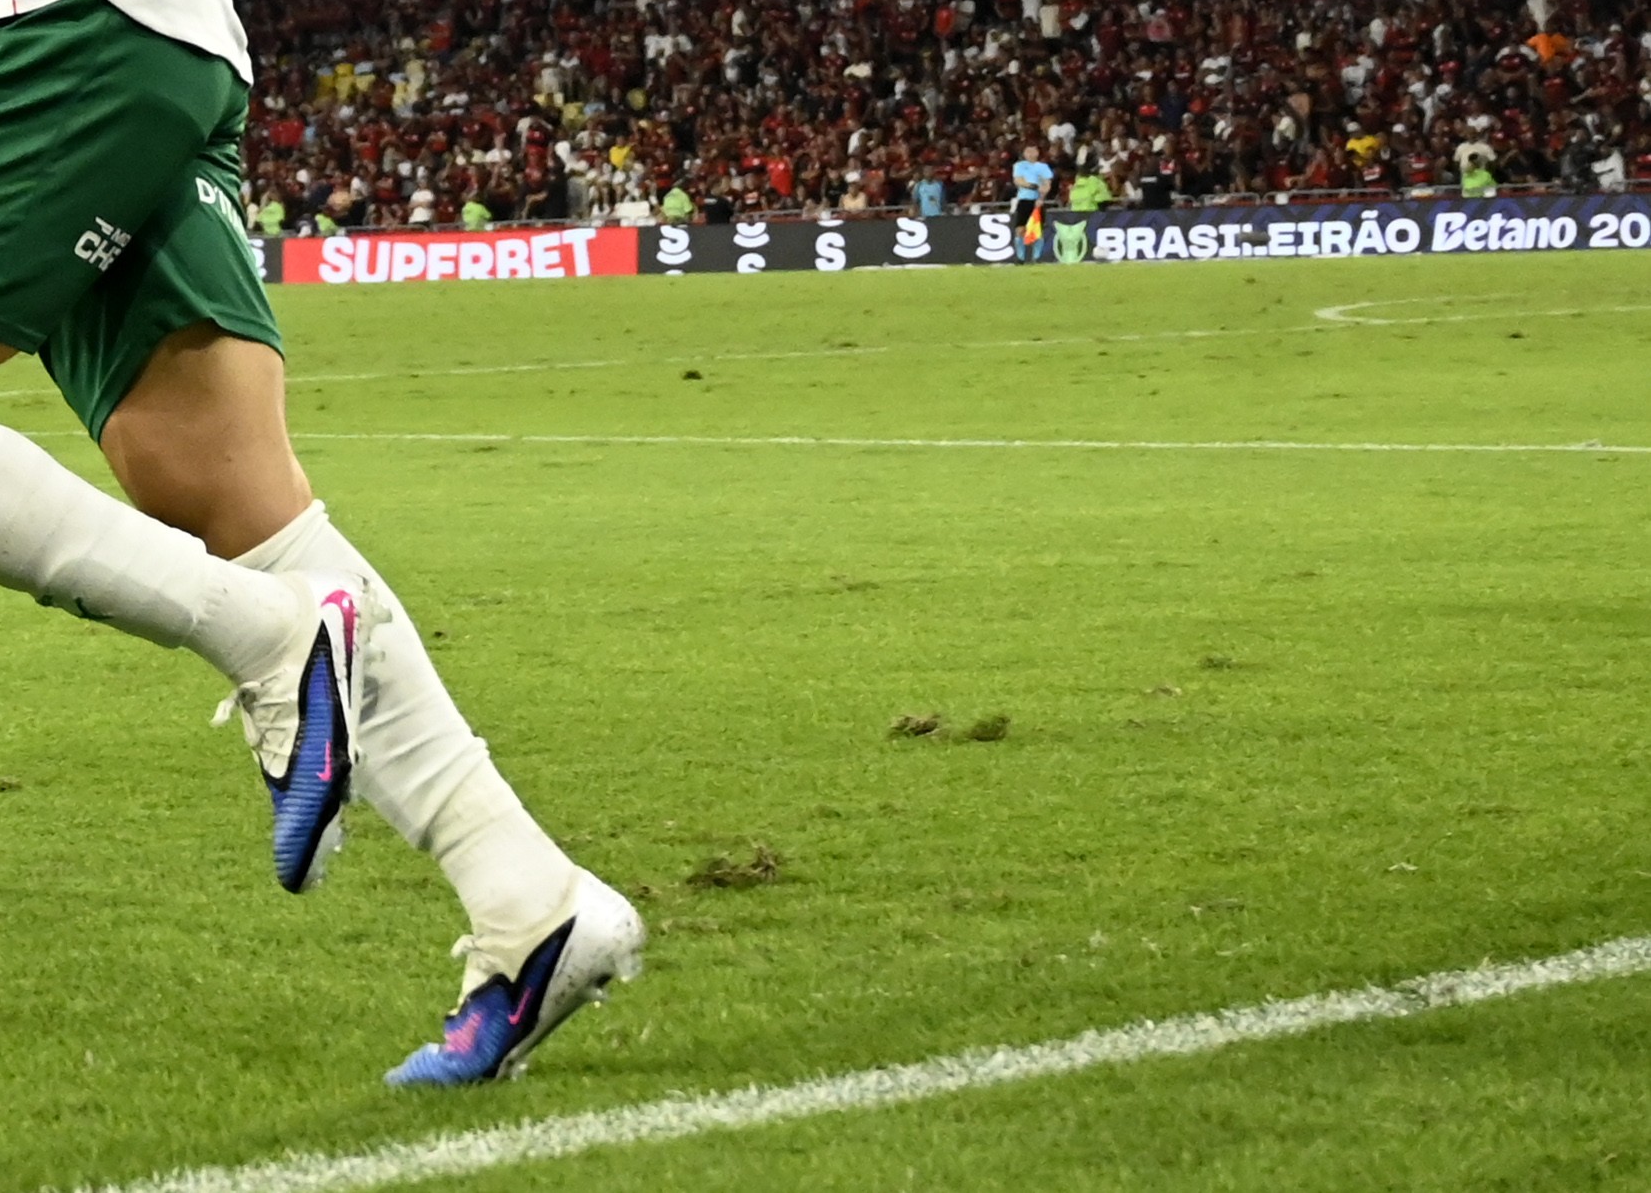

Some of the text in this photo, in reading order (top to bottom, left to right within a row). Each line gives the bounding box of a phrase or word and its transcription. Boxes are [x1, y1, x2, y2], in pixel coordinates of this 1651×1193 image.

[318, 228, 597, 284] SUPERBET
[1096, 210, 1421, 260] BRASILEIRÃO
[1431, 212, 1578, 252] Betano
